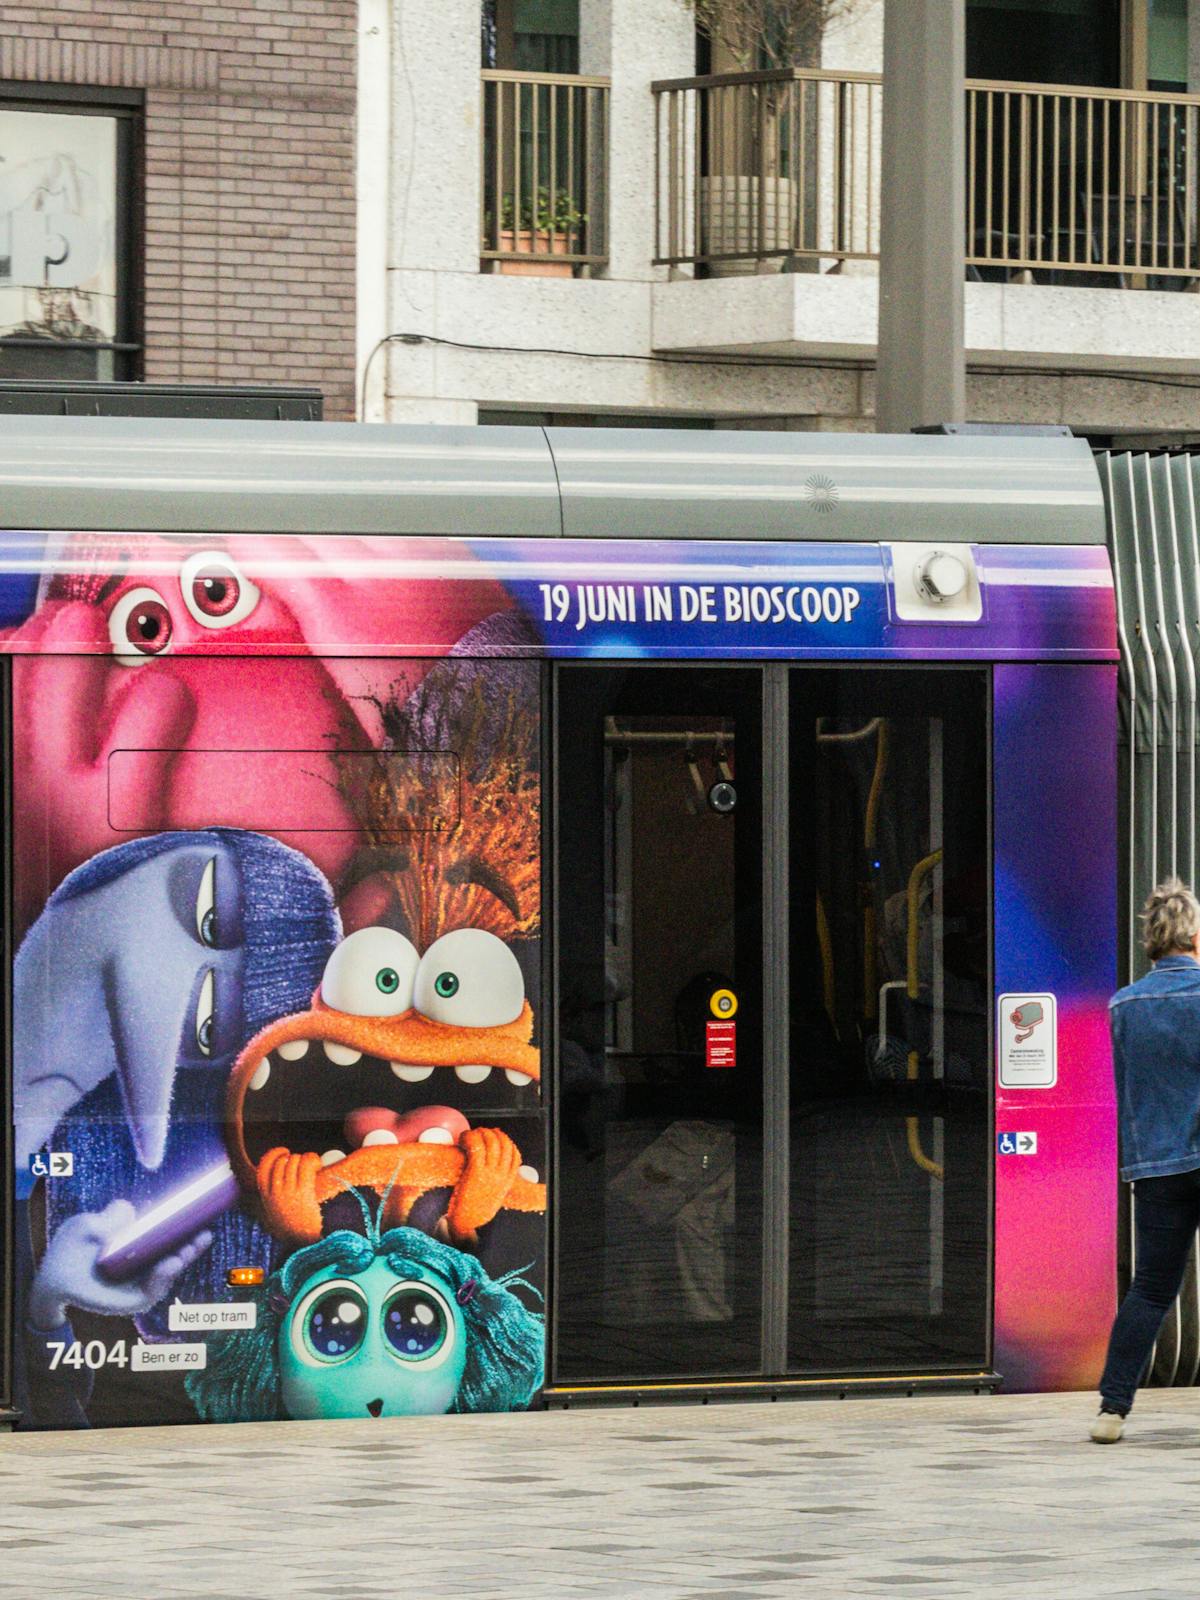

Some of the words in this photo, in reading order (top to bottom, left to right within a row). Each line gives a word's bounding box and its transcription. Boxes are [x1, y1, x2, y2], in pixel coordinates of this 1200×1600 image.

[538, 583, 570, 623] 19
[575, 584, 637, 631] JUNI
[643, 585, 673, 622] IN
[679, 585, 718, 622] DE
[723, 586, 861, 623] BIOSCOOP
[178, 1311, 200, 1323] Net
[202, 1312, 218, 1325] op
[221, 1310, 248, 1323] tram
[46, 1339, 129, 1371] 7404
[141, 1351, 165, 1364] Ben
[168, 1352, 181, 1363] er
[184, 1351, 199, 1363] zo
